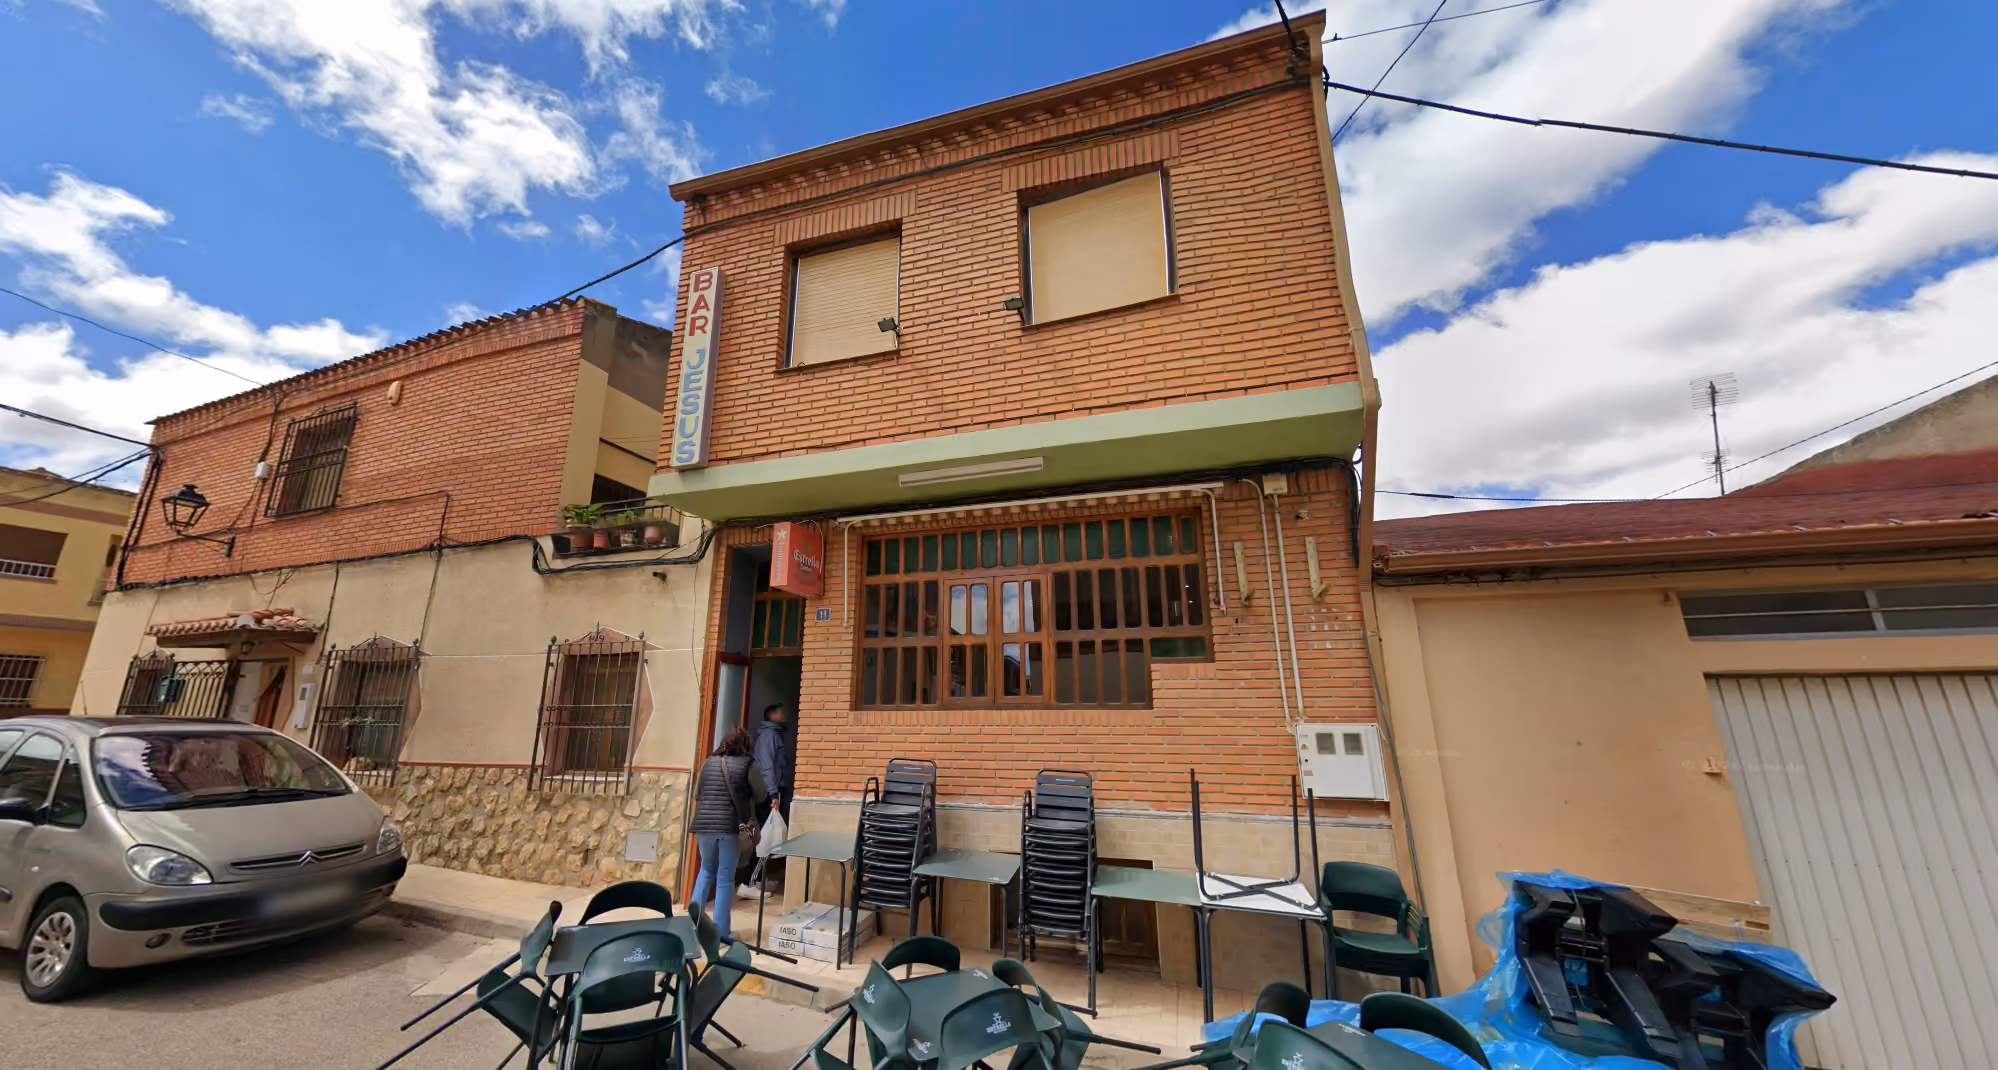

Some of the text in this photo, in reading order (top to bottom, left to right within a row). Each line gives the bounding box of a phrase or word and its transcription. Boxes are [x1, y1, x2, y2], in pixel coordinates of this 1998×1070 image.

[676, 271, 714, 464] BAR JESUS
[793, 549, 820, 569] Estrella
